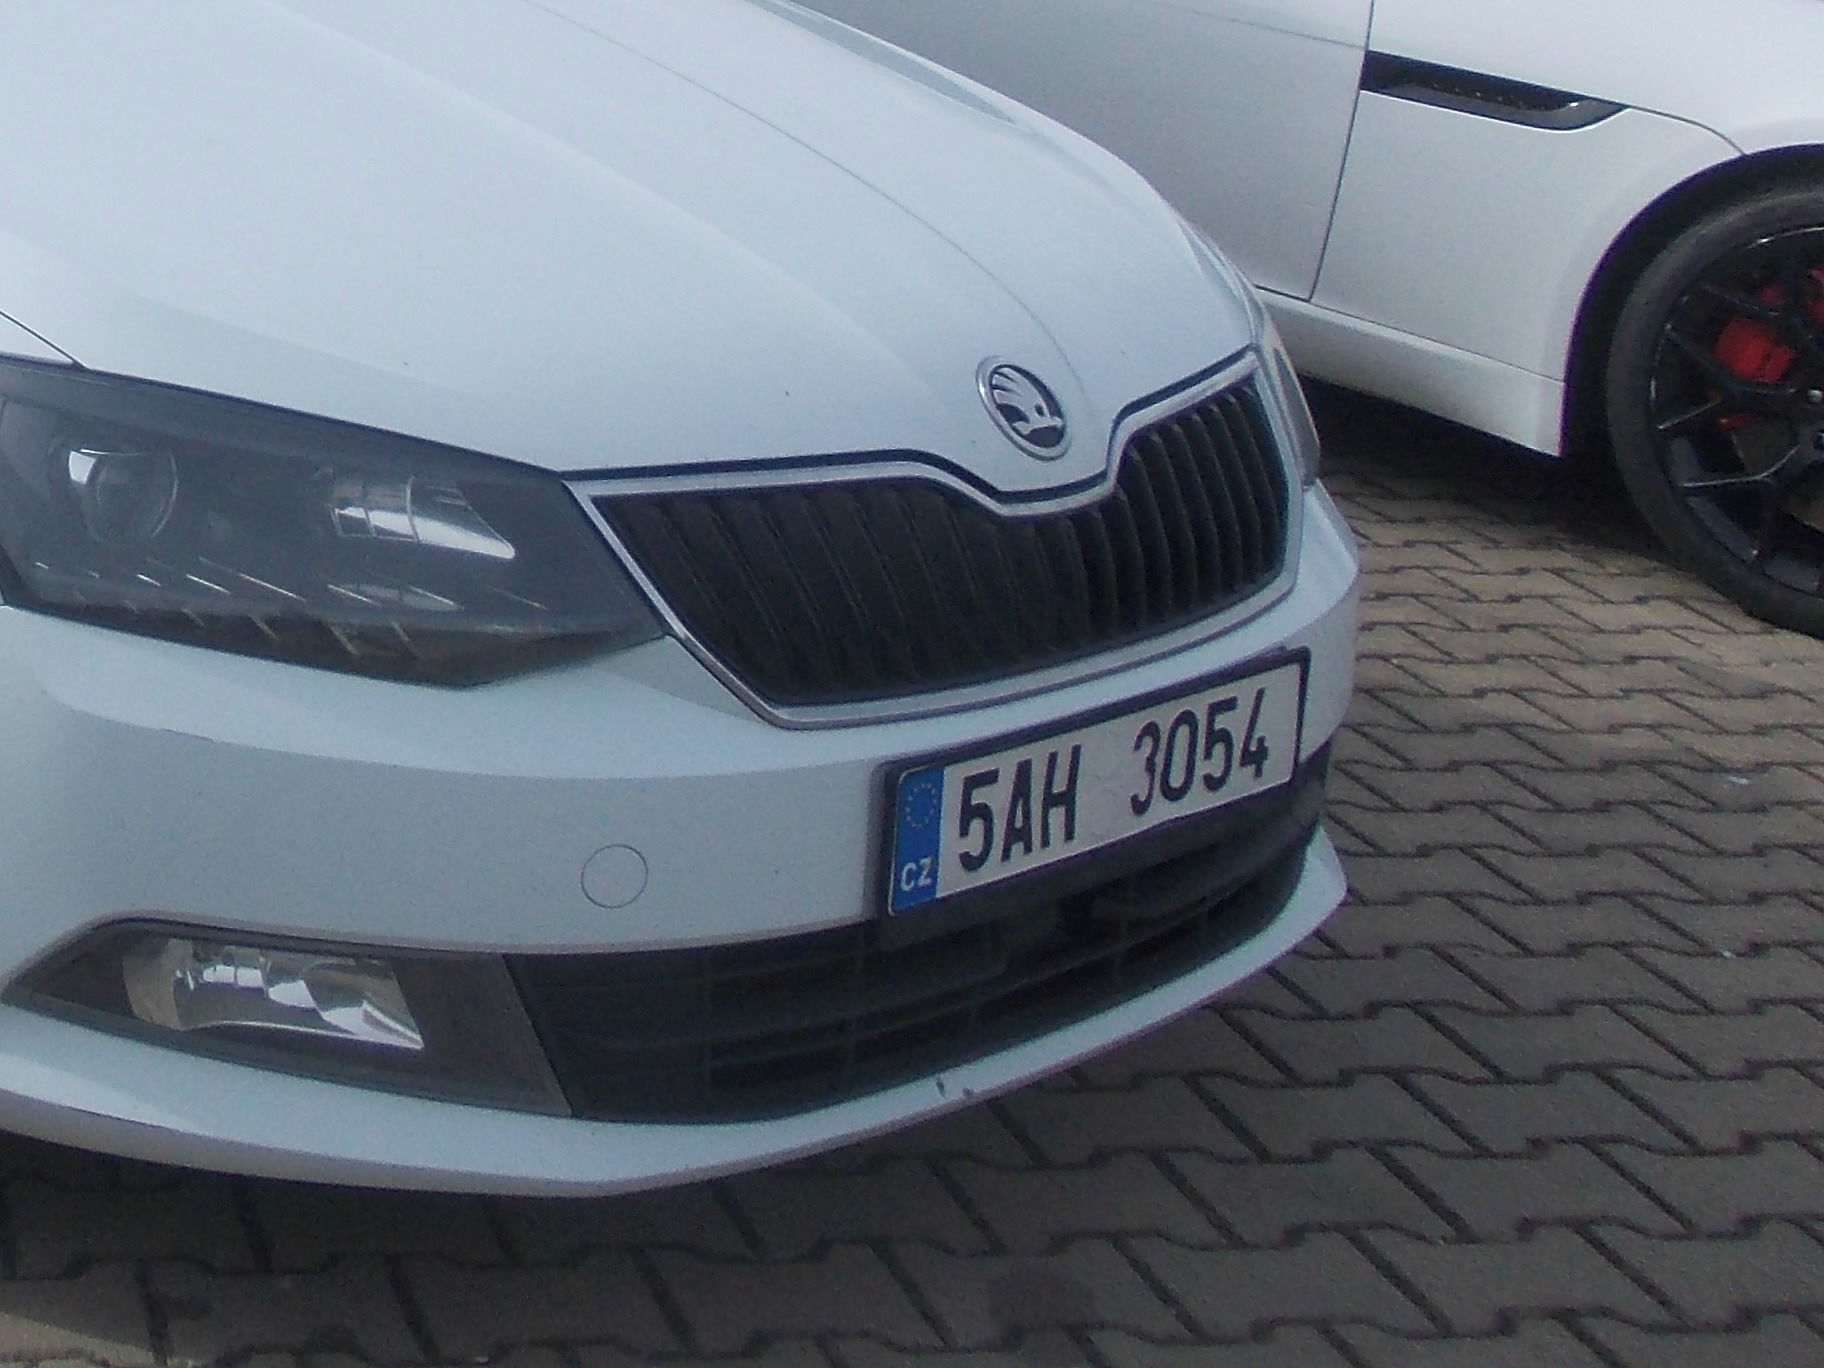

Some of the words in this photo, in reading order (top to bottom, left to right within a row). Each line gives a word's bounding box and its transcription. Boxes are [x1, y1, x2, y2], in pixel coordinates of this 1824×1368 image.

[958, 743, 1083, 872] 5AH
[1130, 687, 1269, 816] 3054
[900, 856, 934, 892] CZ
